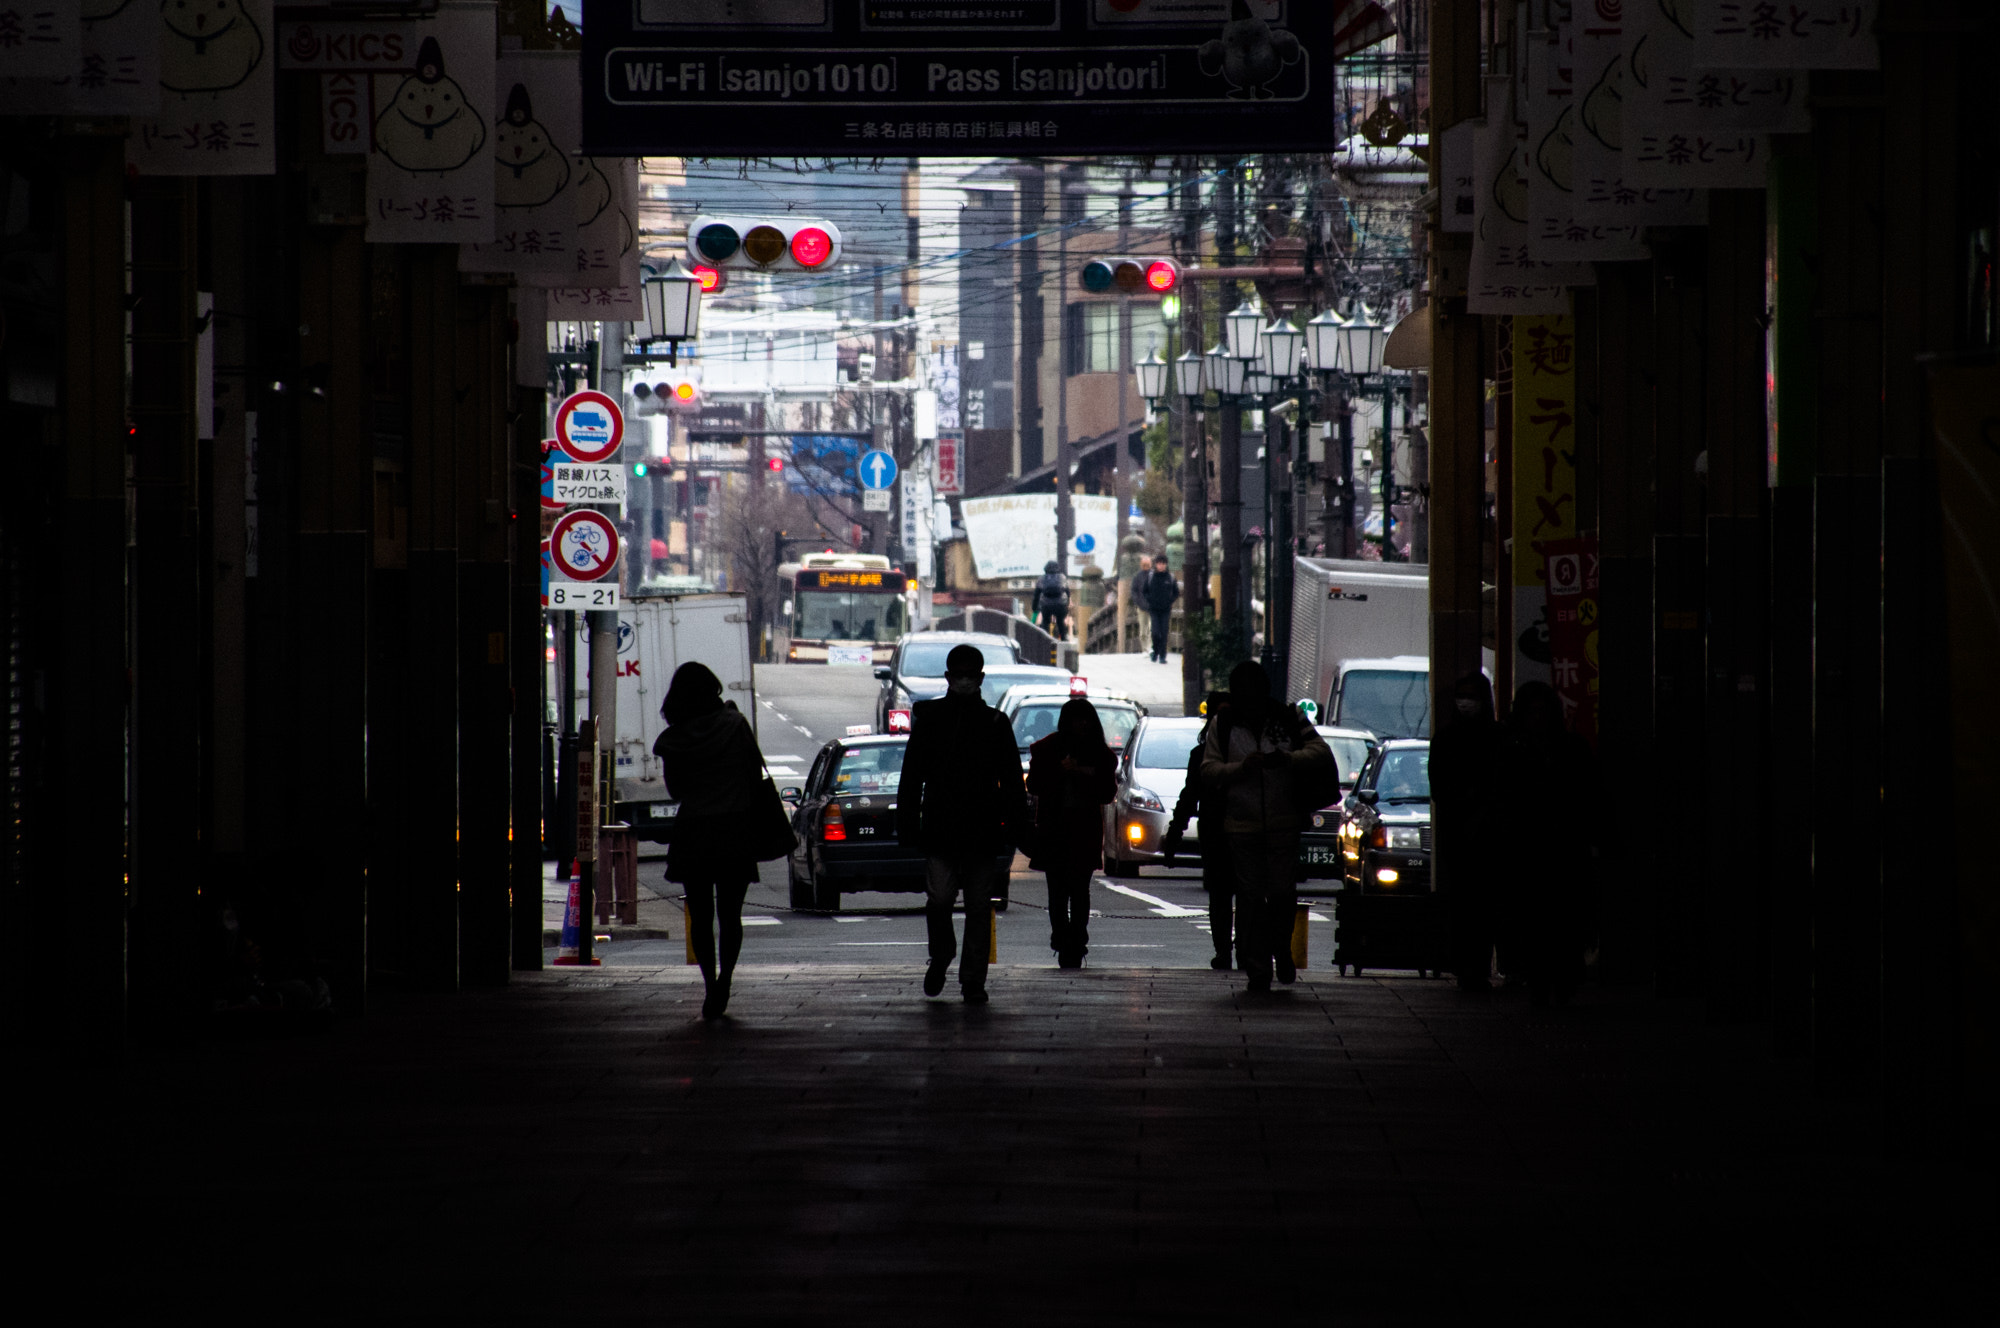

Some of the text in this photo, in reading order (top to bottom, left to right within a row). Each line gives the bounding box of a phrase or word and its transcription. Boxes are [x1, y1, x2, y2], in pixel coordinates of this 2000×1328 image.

[326, 34, 403, 62] KICS
[624, 62, 706, 92] Wi-Fi
[927, 61, 1000, 92] Pass
[844, 120, 1060, 139] 三条名店街商店街振興組合
[557, 486, 620, 499] マイクロを除く
[858, 826, 875, 835] 272
[1307, 852, 1335, 864] 18-52
